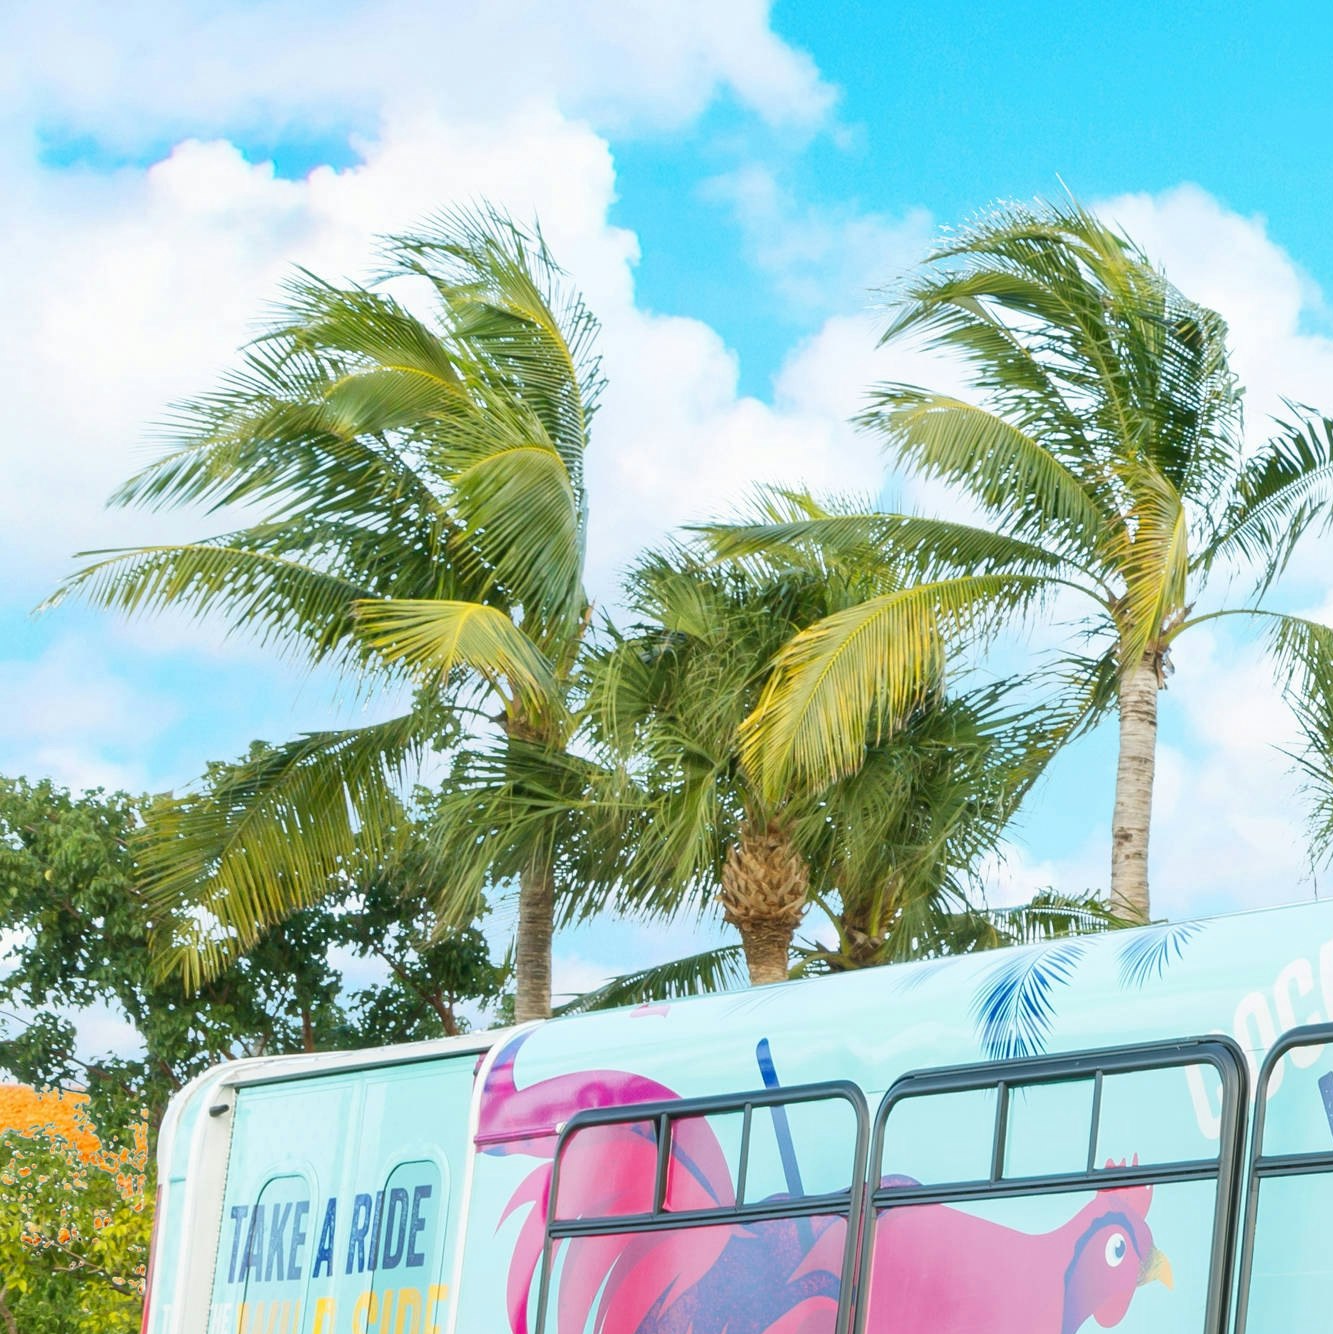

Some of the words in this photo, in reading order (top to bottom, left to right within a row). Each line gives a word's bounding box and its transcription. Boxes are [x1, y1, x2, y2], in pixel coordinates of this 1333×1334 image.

[228, 1201, 309, 1284] TAKE
[313, 1197, 337, 1279] A
[345, 1185, 432, 1275] RIDE
